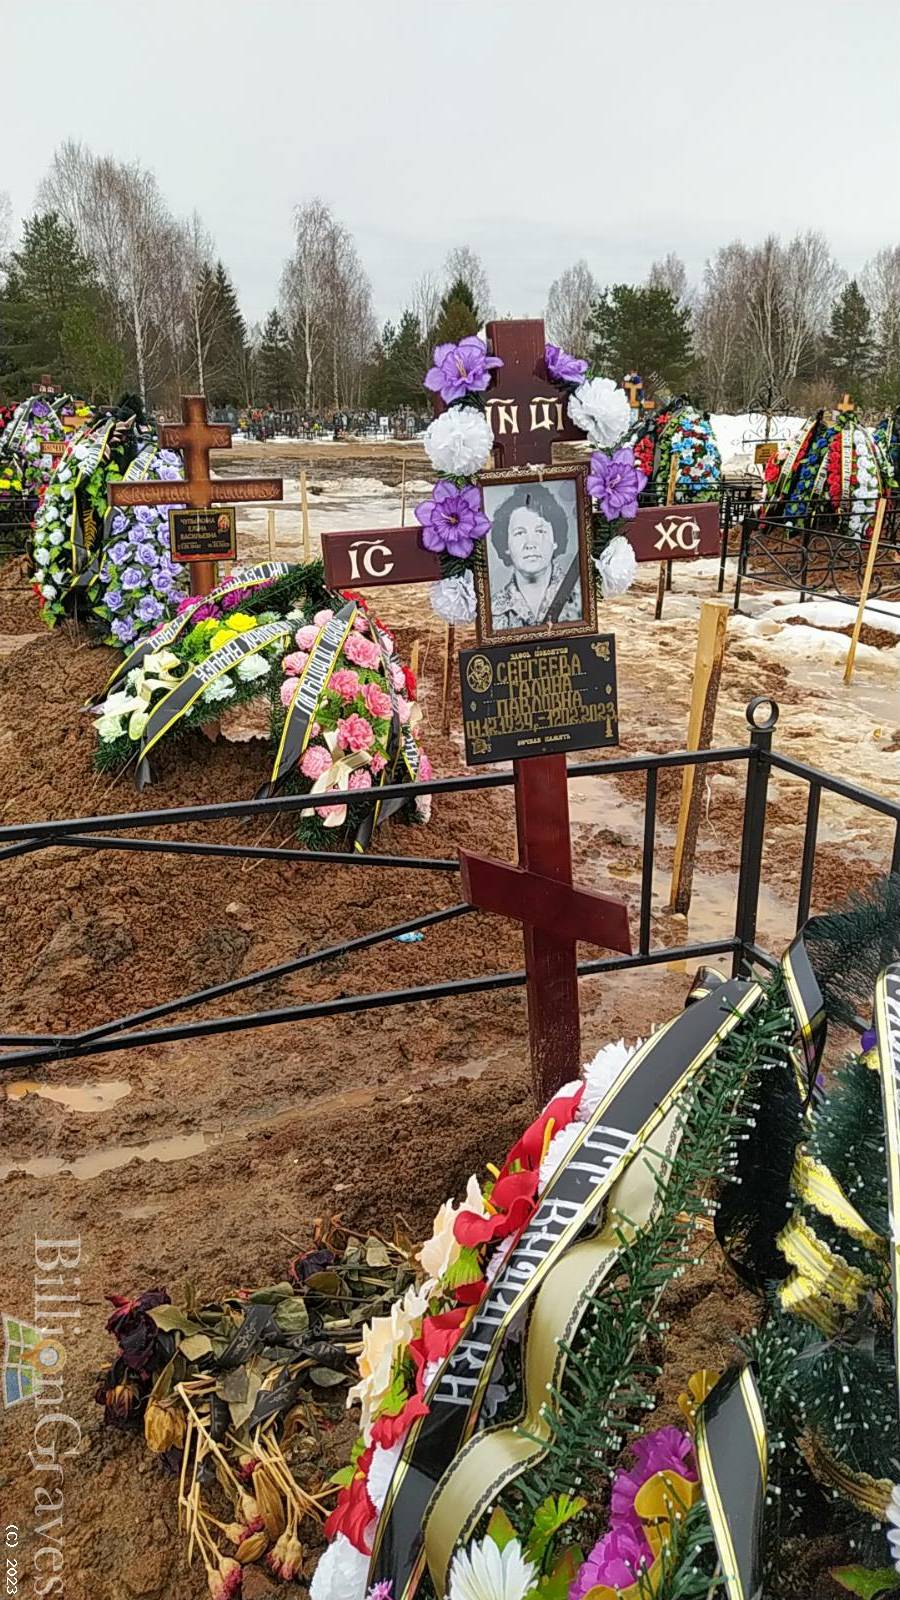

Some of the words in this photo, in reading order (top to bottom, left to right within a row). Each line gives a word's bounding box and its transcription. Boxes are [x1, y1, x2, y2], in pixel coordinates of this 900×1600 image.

[496, 653, 582, 683] СЕРГЕЕВА
[508, 674, 572, 700] ГАЛИНА
[496, 691, 583, 719] ПАВЛОВНА
